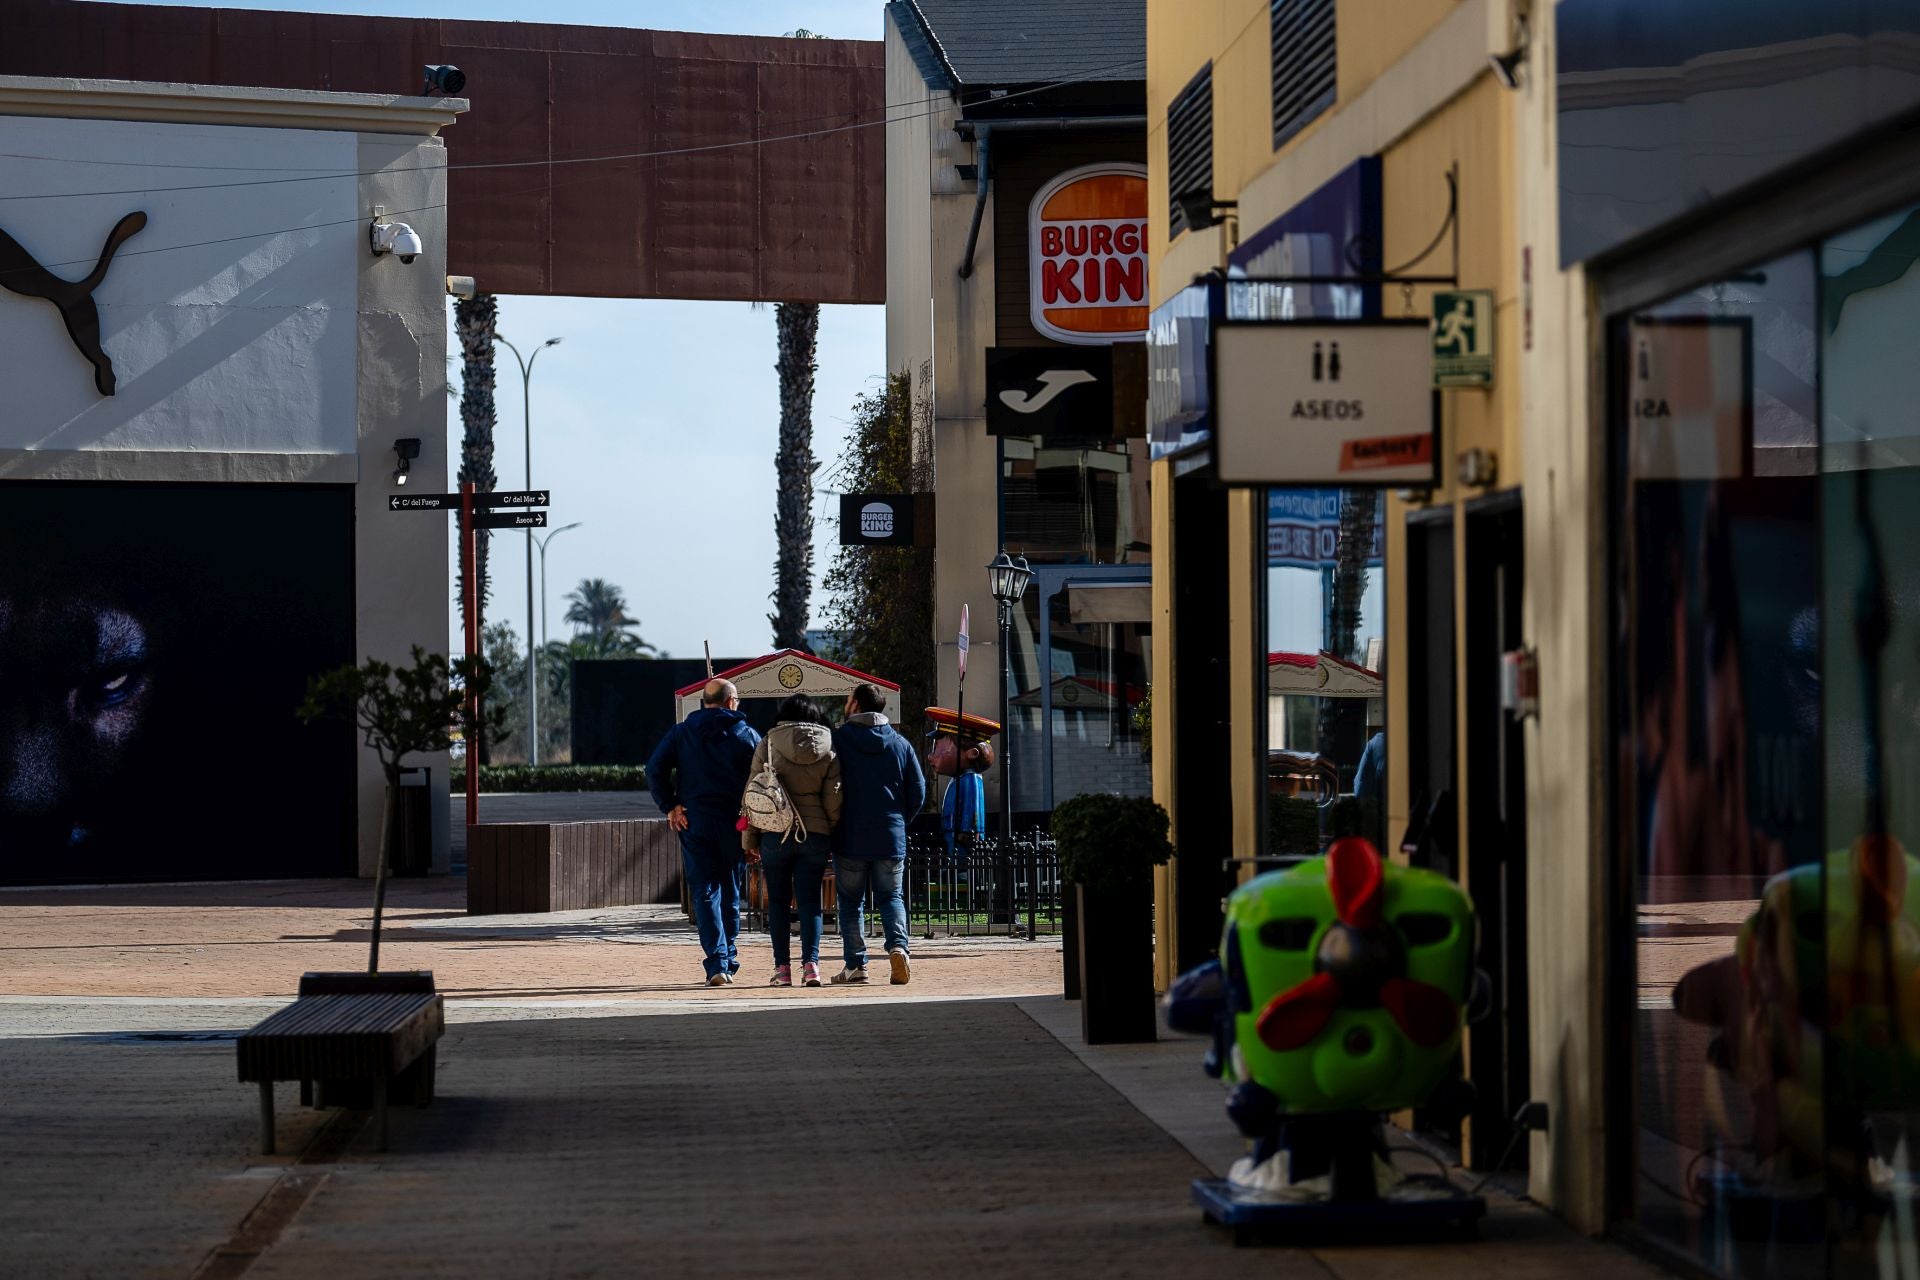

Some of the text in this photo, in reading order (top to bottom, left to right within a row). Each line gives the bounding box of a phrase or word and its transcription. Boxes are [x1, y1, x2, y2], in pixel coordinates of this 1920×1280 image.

[1042, 257, 1149, 304] KIN
[1291, 400, 1363, 420] ASEOS
[421, 499, 440, 507] Fuego
[523, 495, 536, 503] Mar
[861, 513, 893, 521] BURGER
[861, 520, 893, 531] KING
